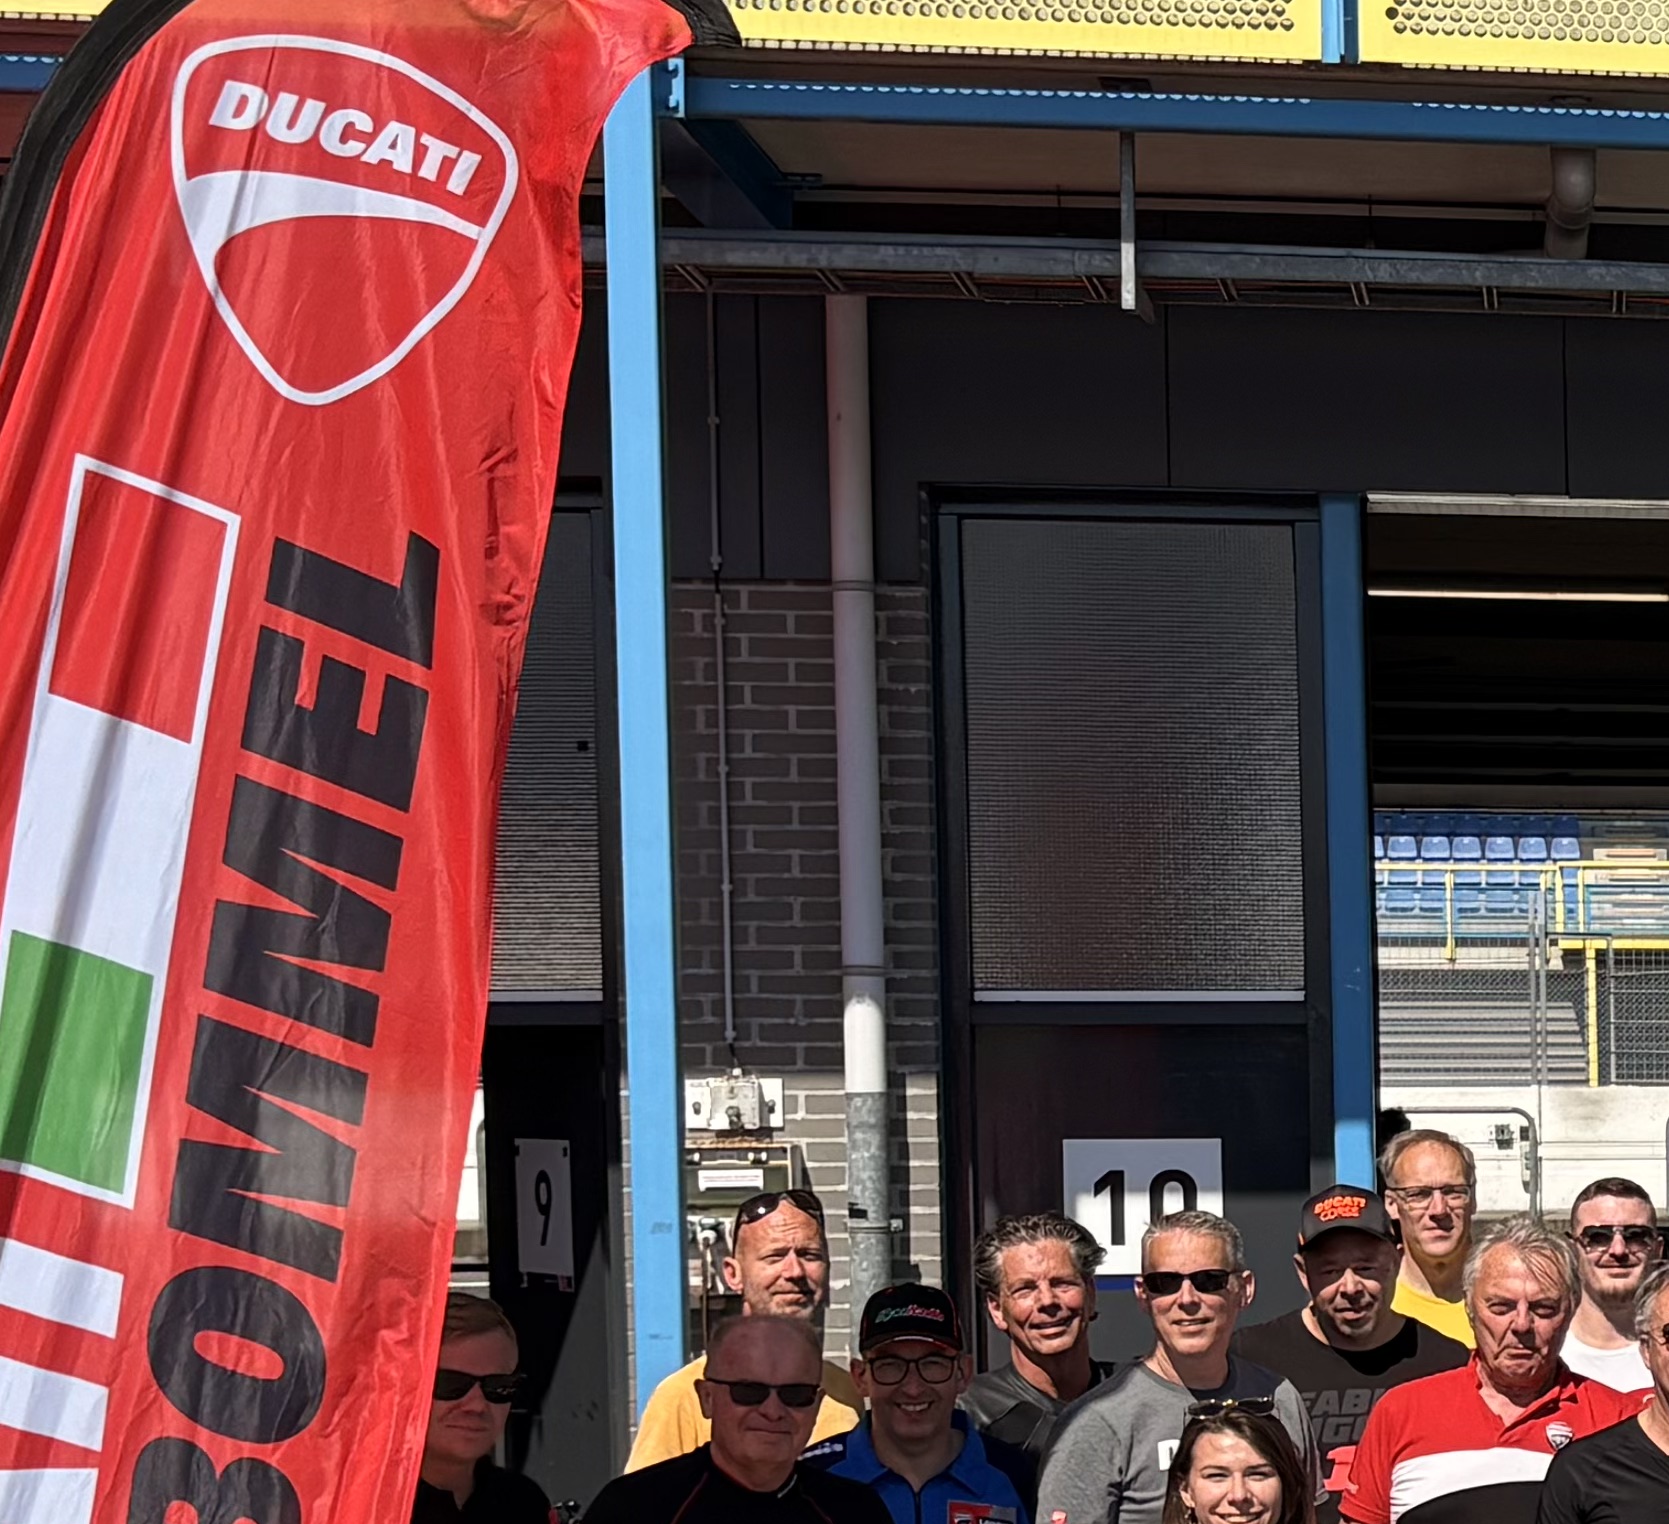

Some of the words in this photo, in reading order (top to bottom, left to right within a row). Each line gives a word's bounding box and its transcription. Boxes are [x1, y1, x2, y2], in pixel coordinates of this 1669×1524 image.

[209, 80, 482, 195] DUCATI
[535, 1169, 552, 1246] 9
[1093, 1169, 1200, 1246] 10
[1314, 1196, 1366, 1214] DUCATI
